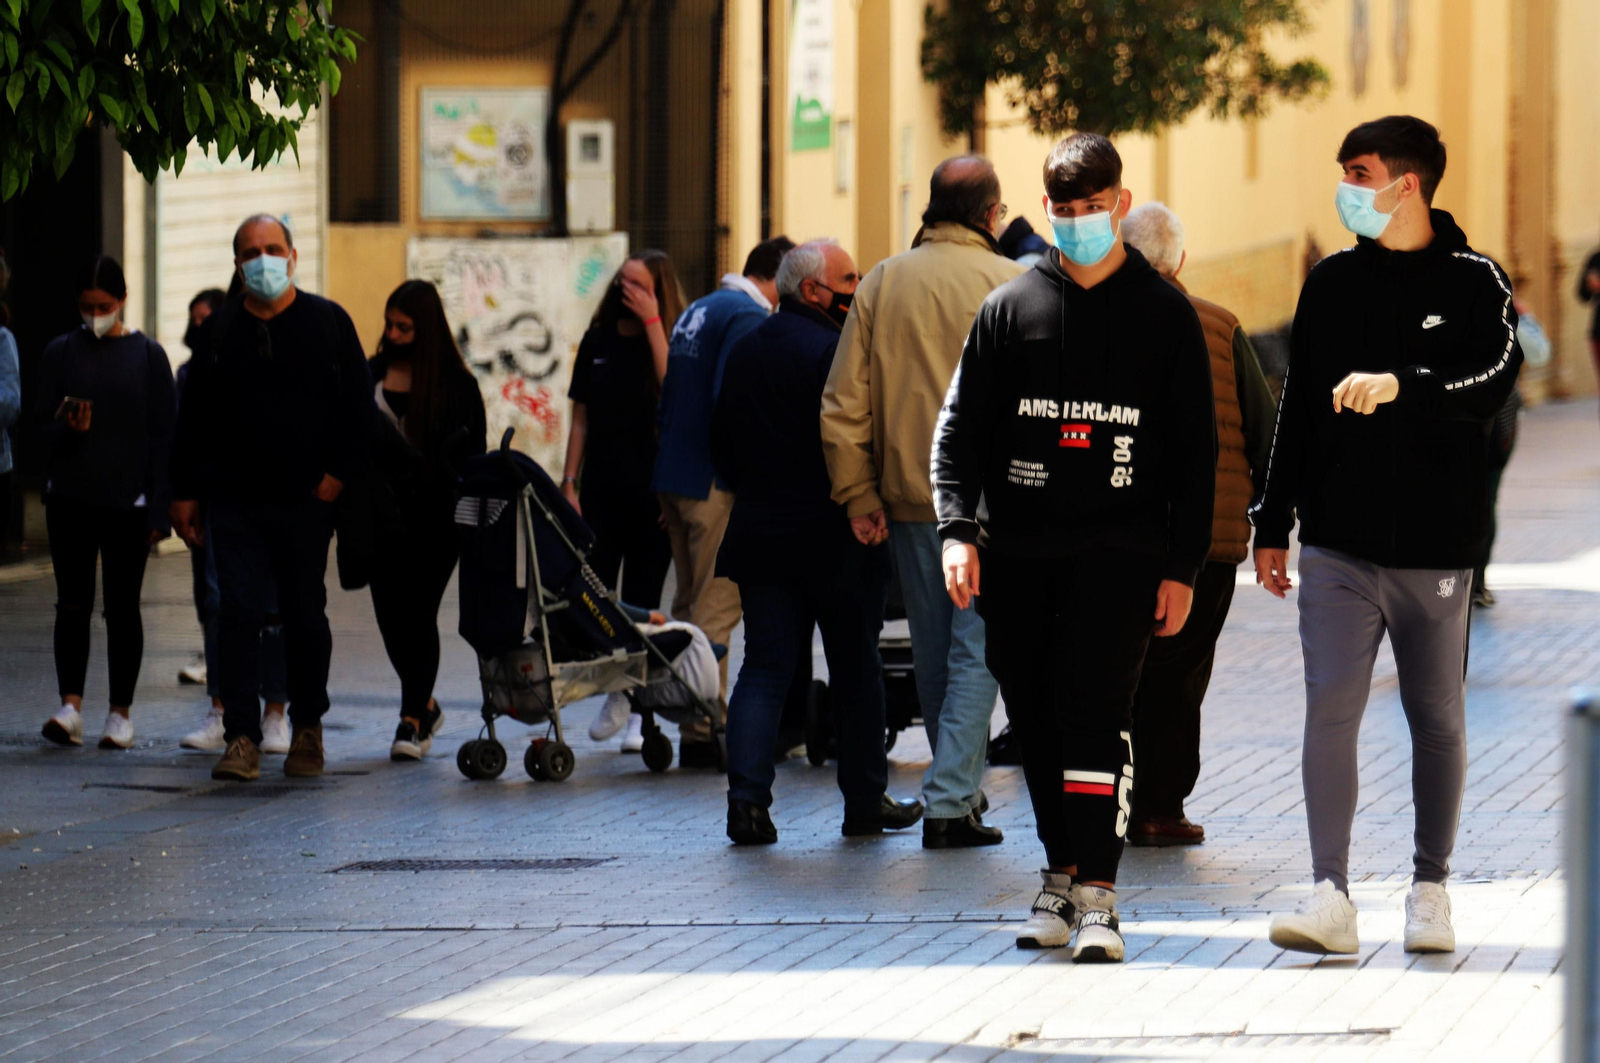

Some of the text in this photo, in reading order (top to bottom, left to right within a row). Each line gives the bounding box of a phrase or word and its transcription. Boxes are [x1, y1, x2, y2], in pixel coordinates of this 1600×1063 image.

[1023, 478, 1034, 487] ART
[1034, 479, 1046, 488] CITY
[1034, 892, 1067, 913] NIKE
[1079, 911, 1112, 928] NIKE
